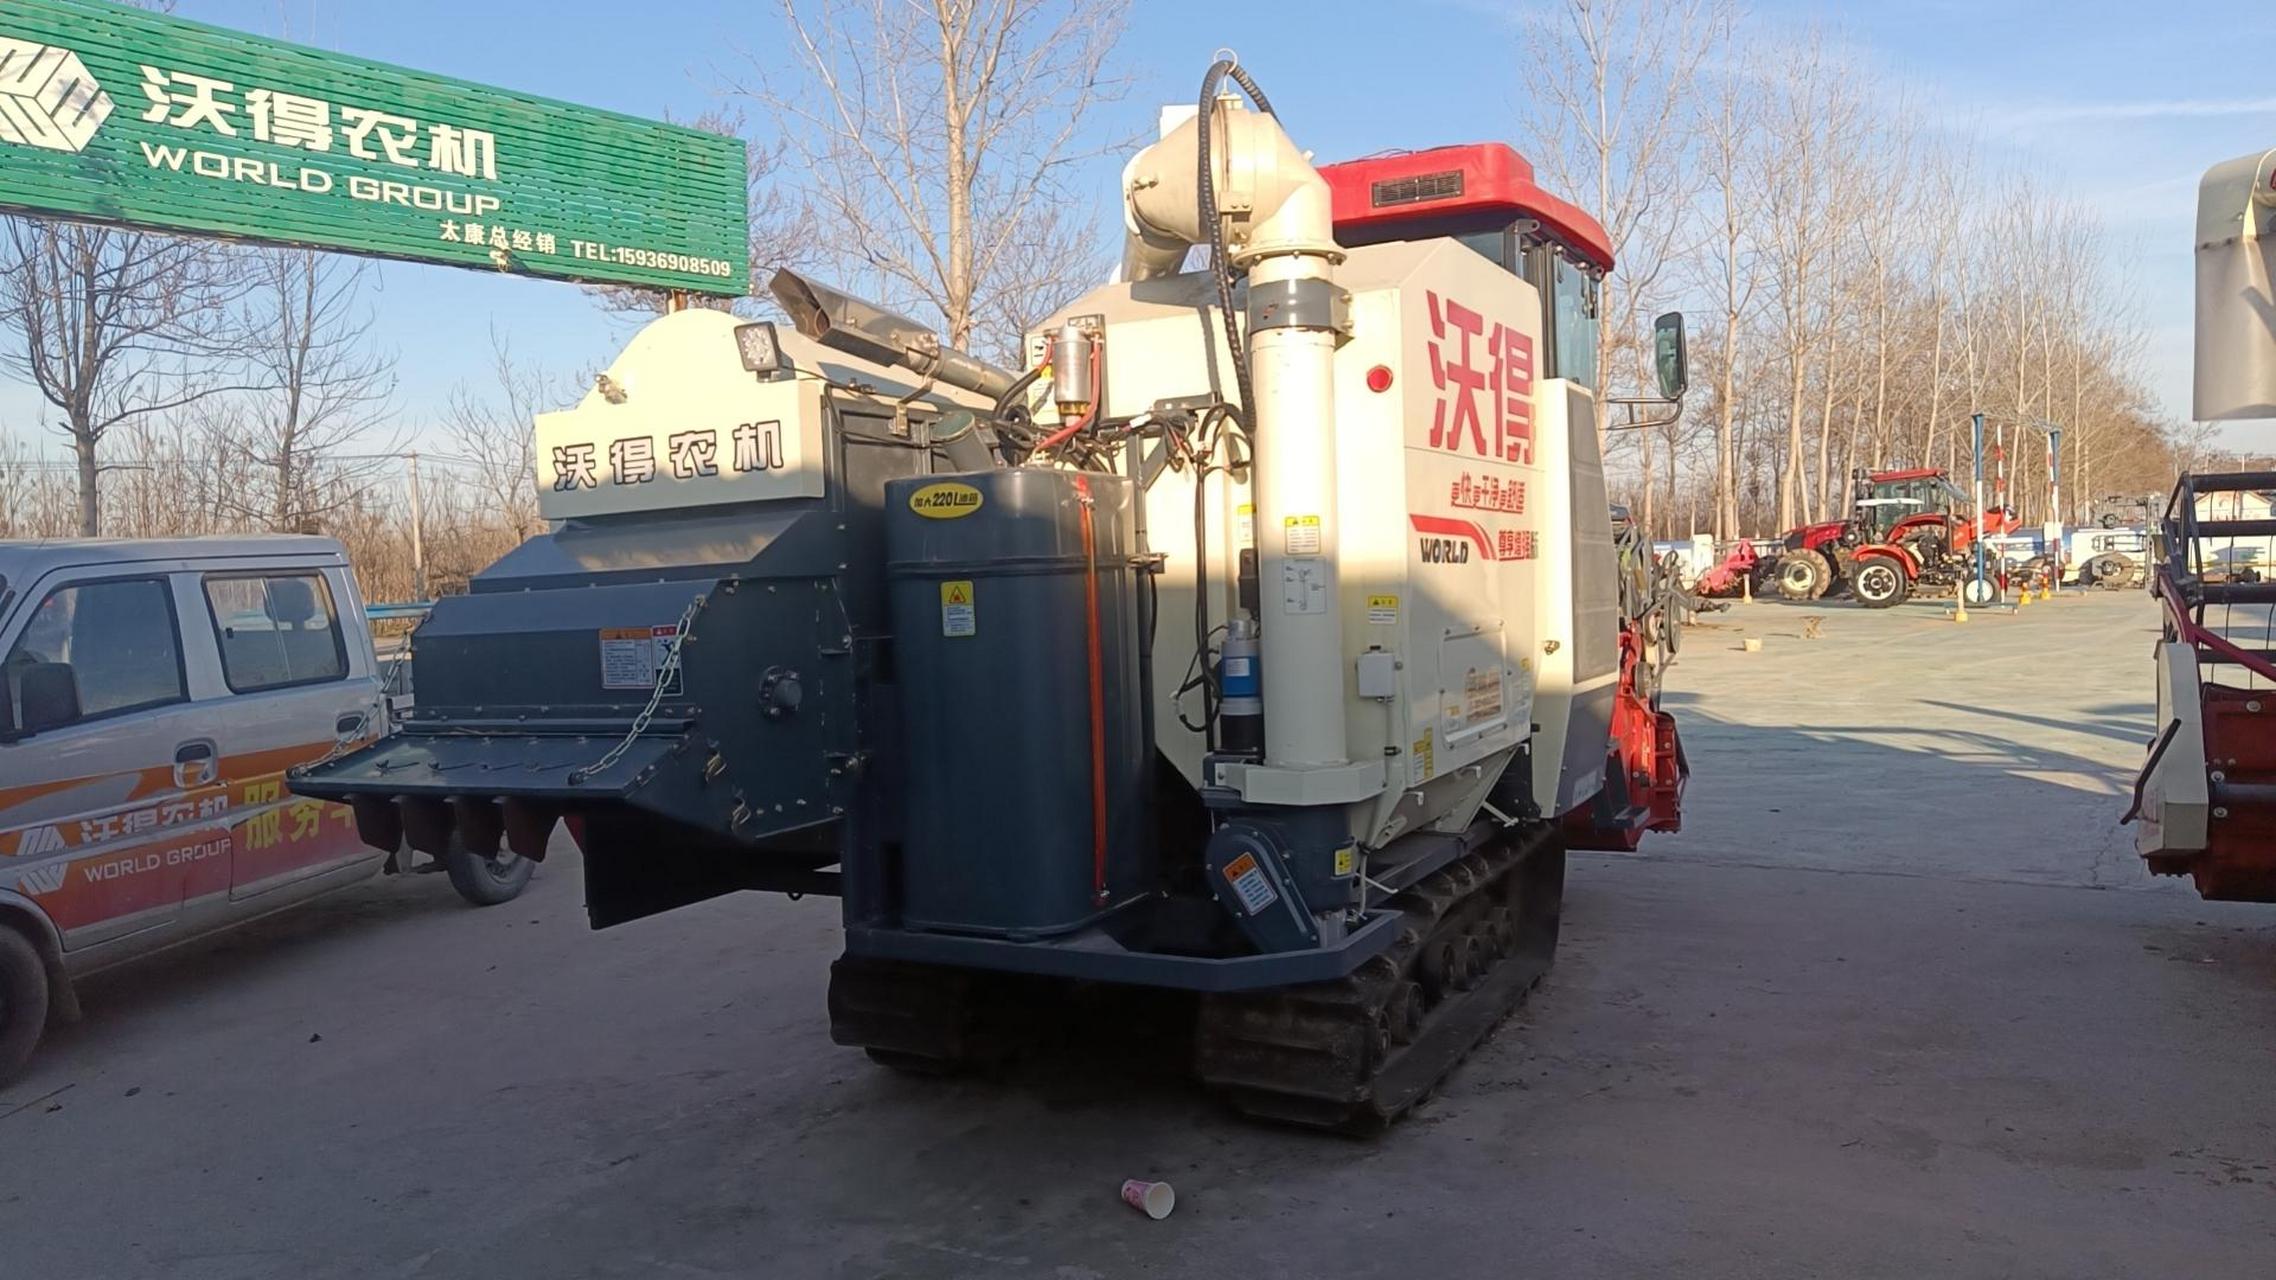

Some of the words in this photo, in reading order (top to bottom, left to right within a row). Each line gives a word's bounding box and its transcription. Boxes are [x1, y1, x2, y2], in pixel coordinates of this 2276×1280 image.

[140, 65, 498, 181] 沃得农机
[139, 140, 334, 194] WORLD
[348, 176, 502, 217] GROUP
[439, 219, 557, 255] 太康总经销
[570, 239, 732, 277] TEL:15936908509
[1425, 289, 1535, 465] 沃得
[552, 420, 784, 492] 沃得农机
[1419, 537, 1470, 565] WORLD
[80, 795, 230, 843] 沃得农机
[84, 854, 161, 884] WORLD
[166, 838, 232, 866] GROUP
